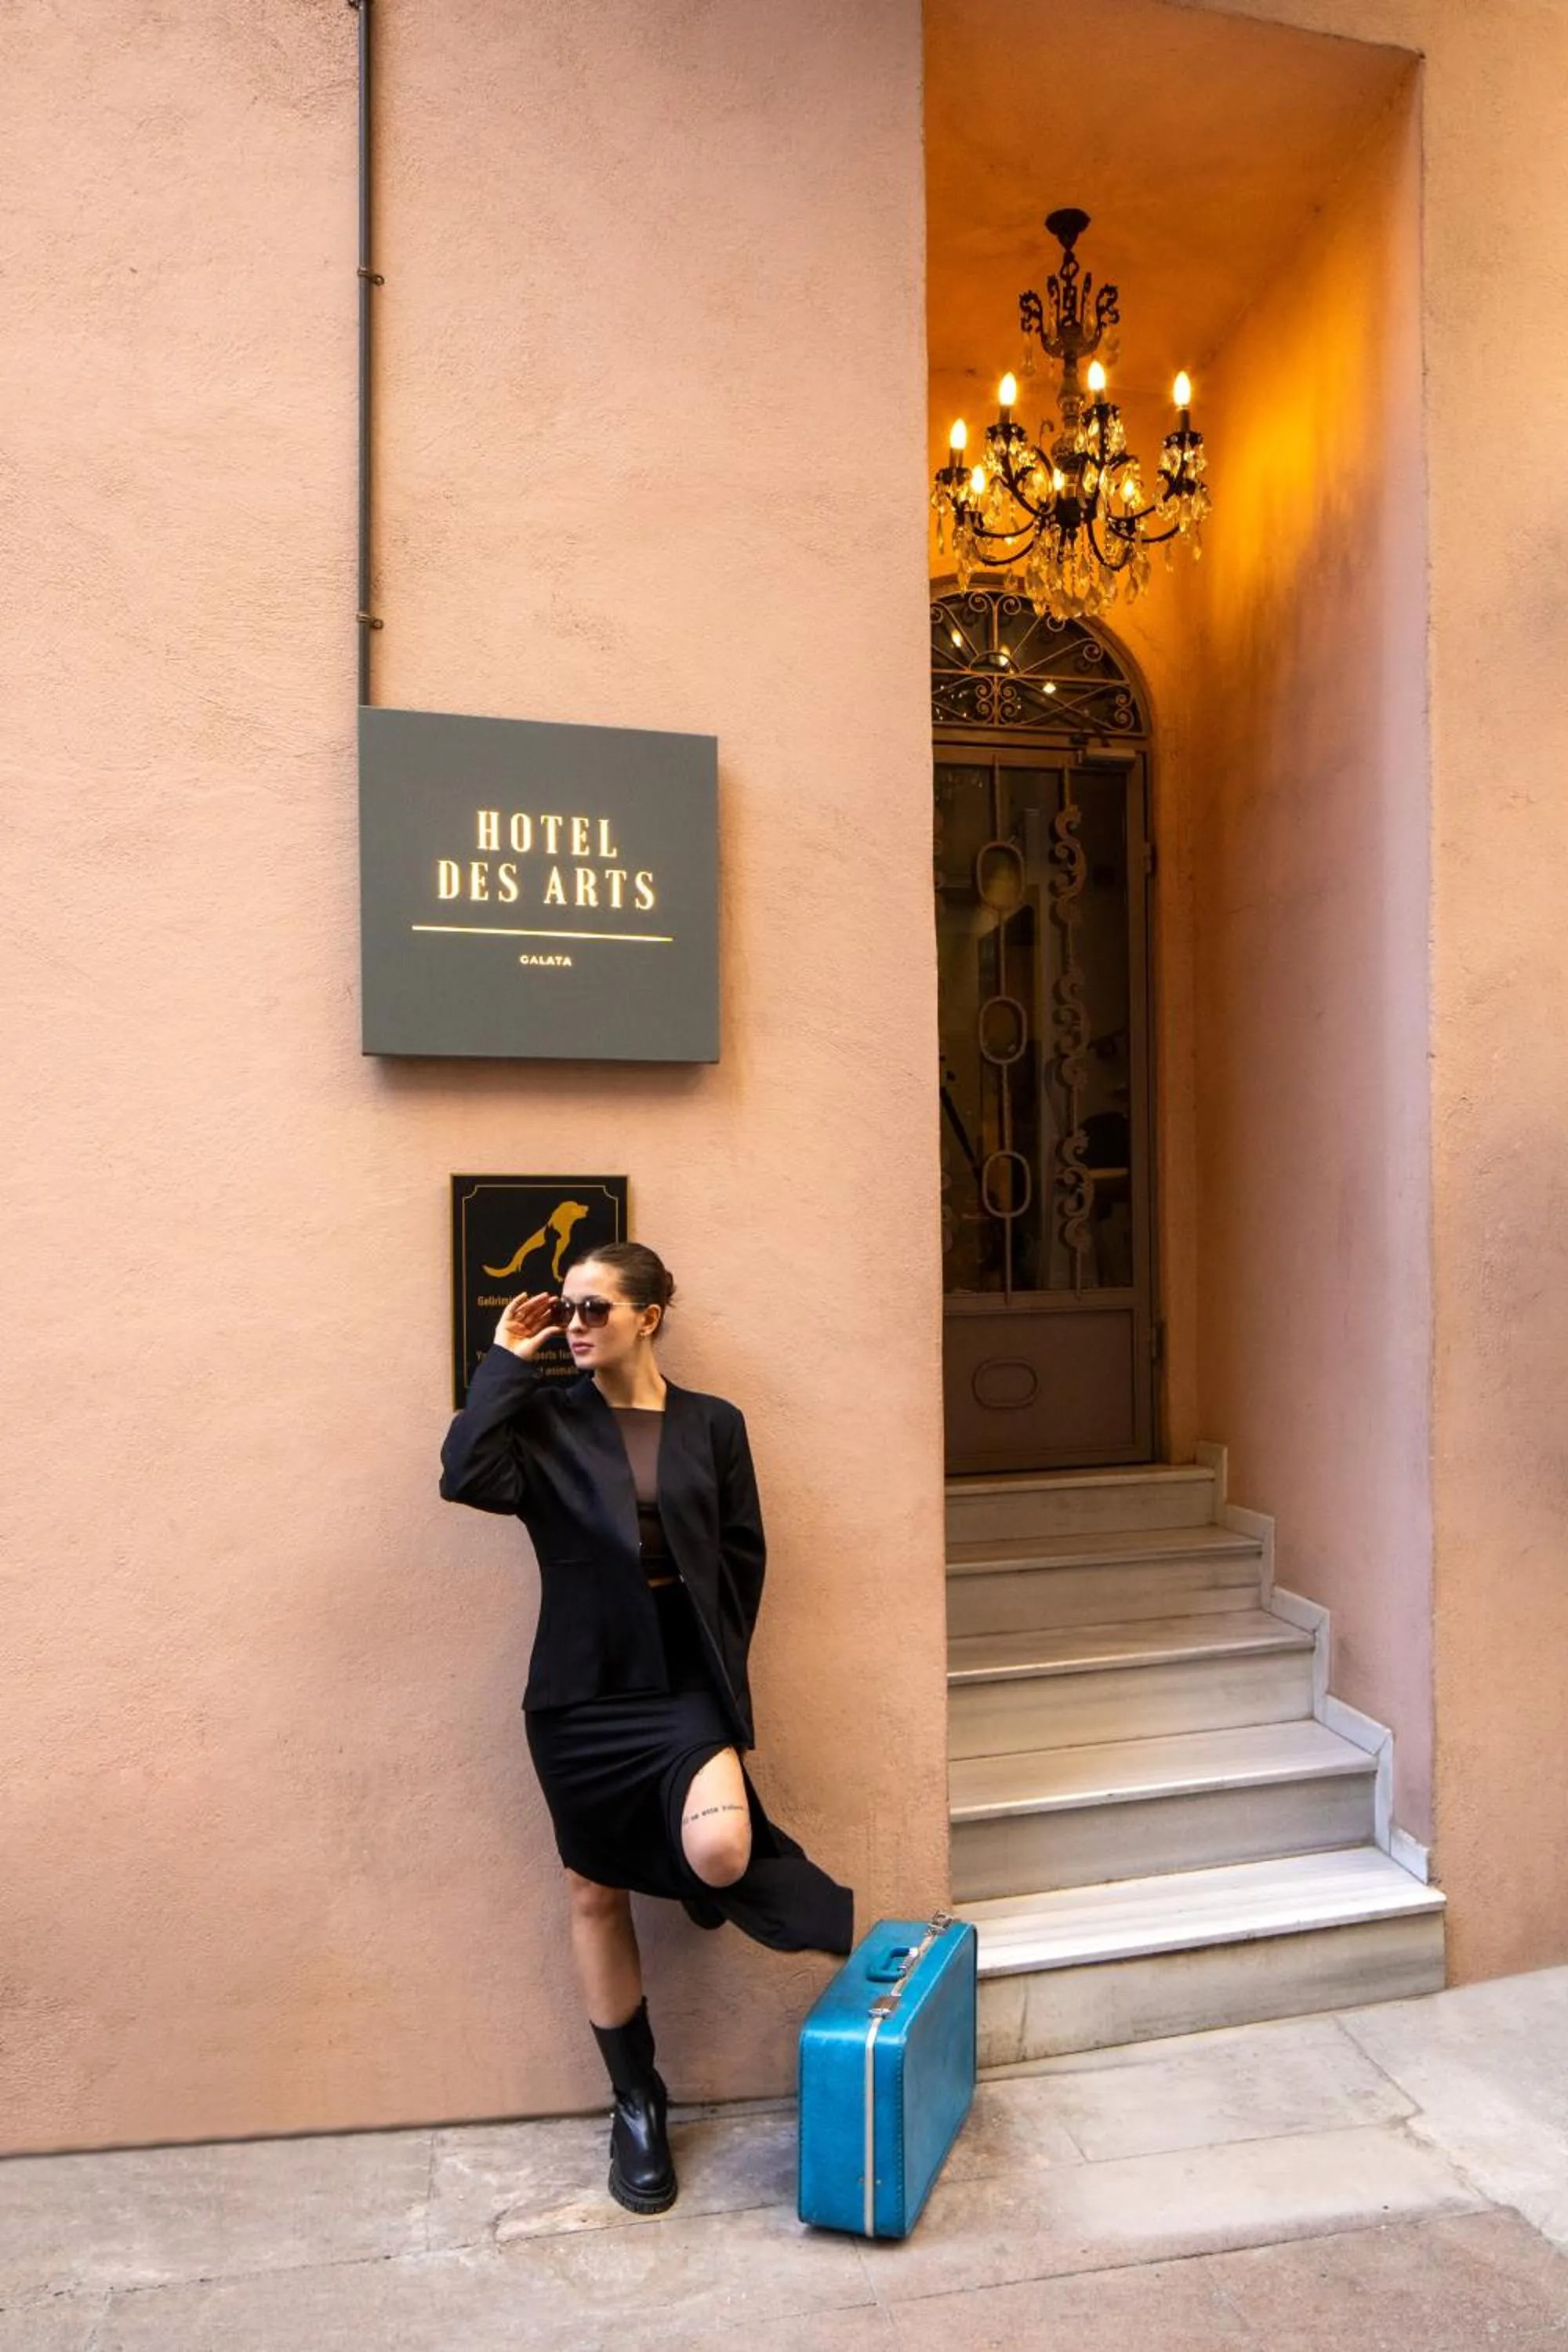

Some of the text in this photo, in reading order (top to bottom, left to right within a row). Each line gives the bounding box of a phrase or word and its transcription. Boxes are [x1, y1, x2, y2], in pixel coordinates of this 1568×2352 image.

[475, 810, 619, 858] HOTEL
[437, 859, 655, 911] DES ARTS
[519, 954, 572, 967] GALATA
